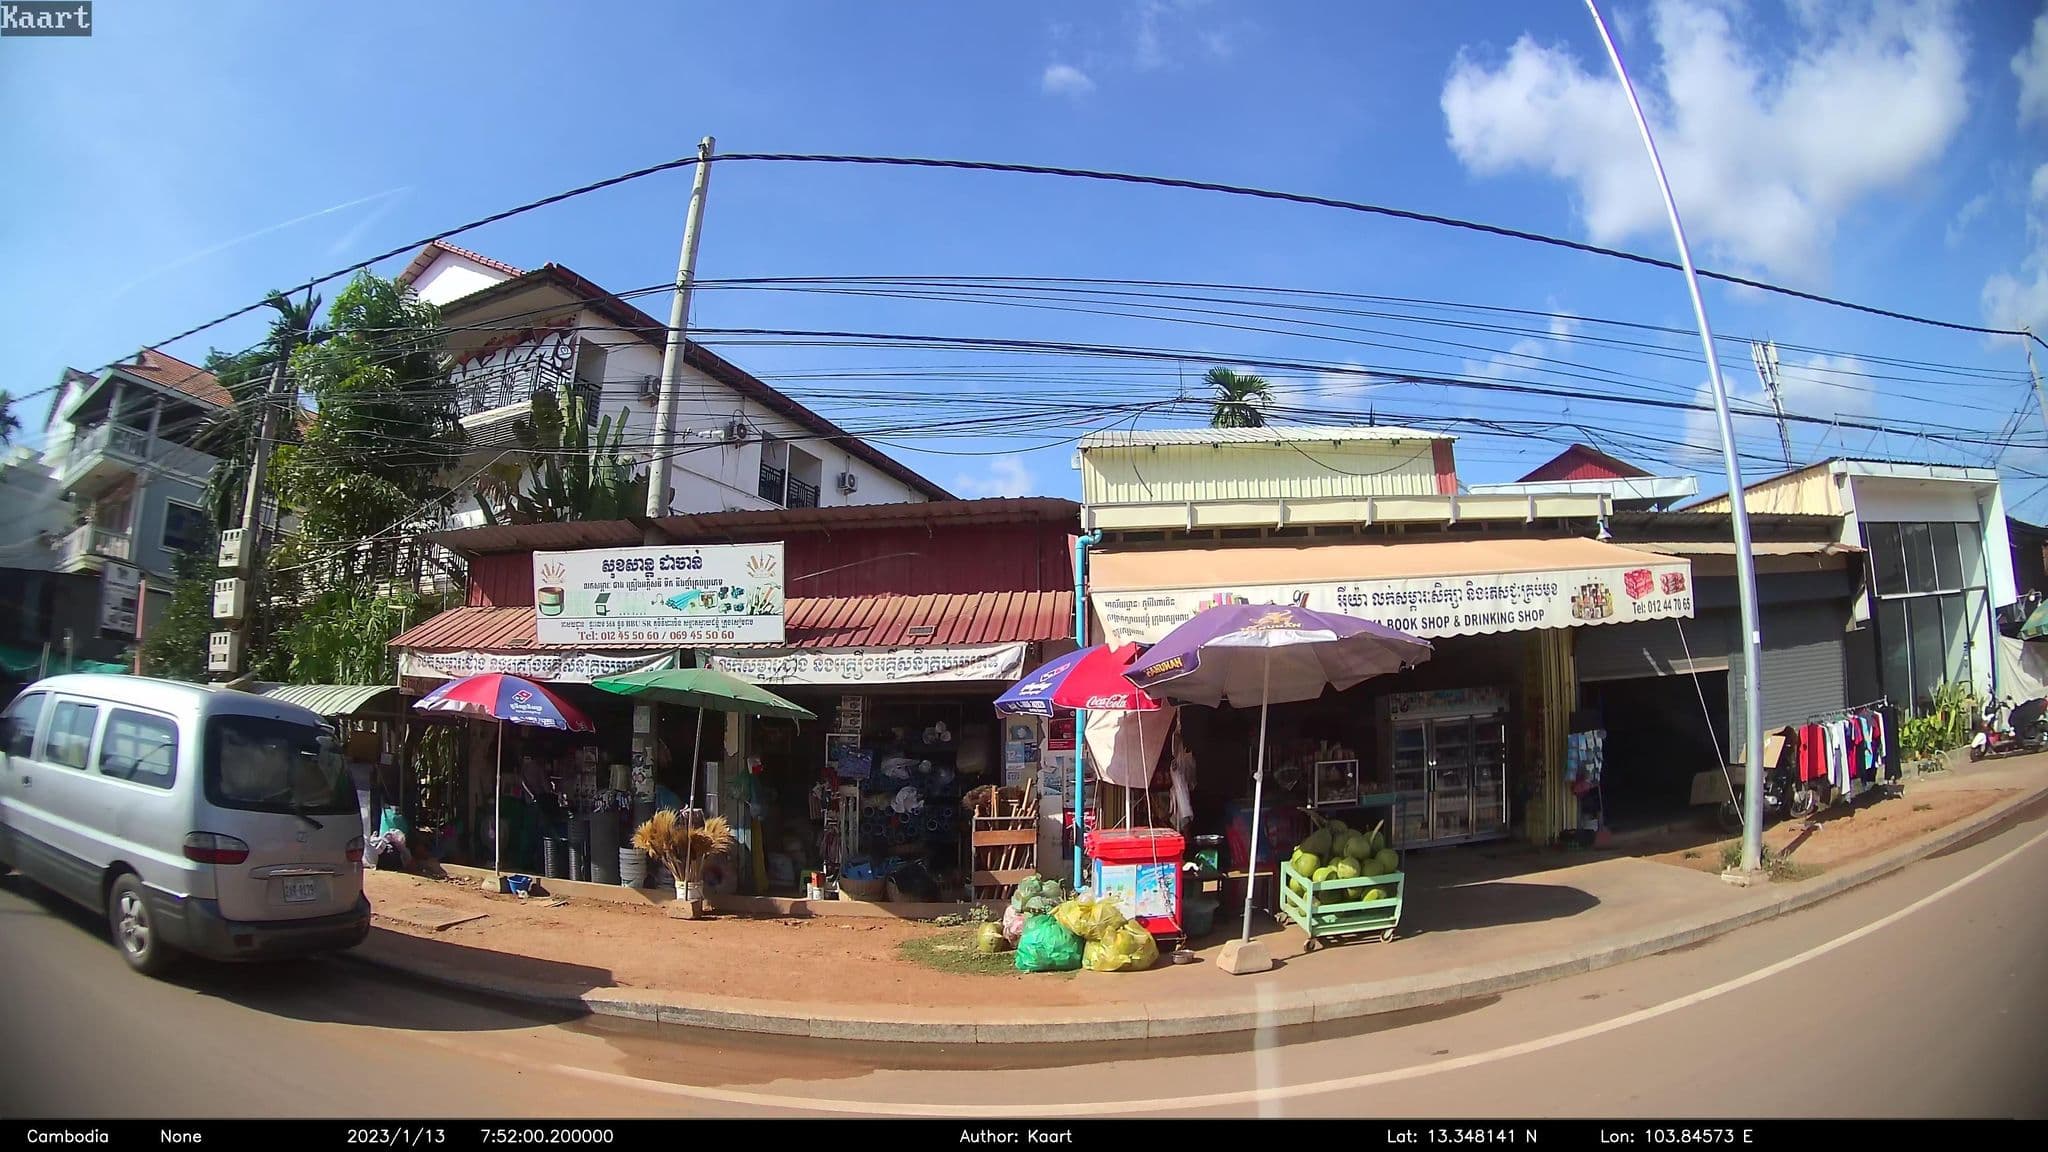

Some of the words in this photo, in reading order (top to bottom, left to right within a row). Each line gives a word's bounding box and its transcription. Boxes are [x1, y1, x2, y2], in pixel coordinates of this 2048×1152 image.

[1632, 601, 1646, 615] Tel:
[1647, 599, 1661, 614] 012
[1663, 598, 1672, 611] 44
[1673, 597, 1682, 611] 70
[1682, 597, 1691, 610] 65
[1387, 617, 1418, 631] BOOK
[1421, 615, 1450, 630] SHOP
[1453, 615, 1461, 628] &
[1464, 611, 1515, 627] DRINKING
[1518, 608, 1545, 624] SHOP
[578, 631, 598, 641] Tel:
[600, 631, 616, 641] 012
[618, 631, 630, 640] 45
[632, 631, 644, 640] 50
[646, 631, 659, 640] 60
[669, 631, 687, 640] 069
[690, 631, 702, 640] 45
[705, 631, 718, 640] 50
[721, 631, 735, 640] 60
